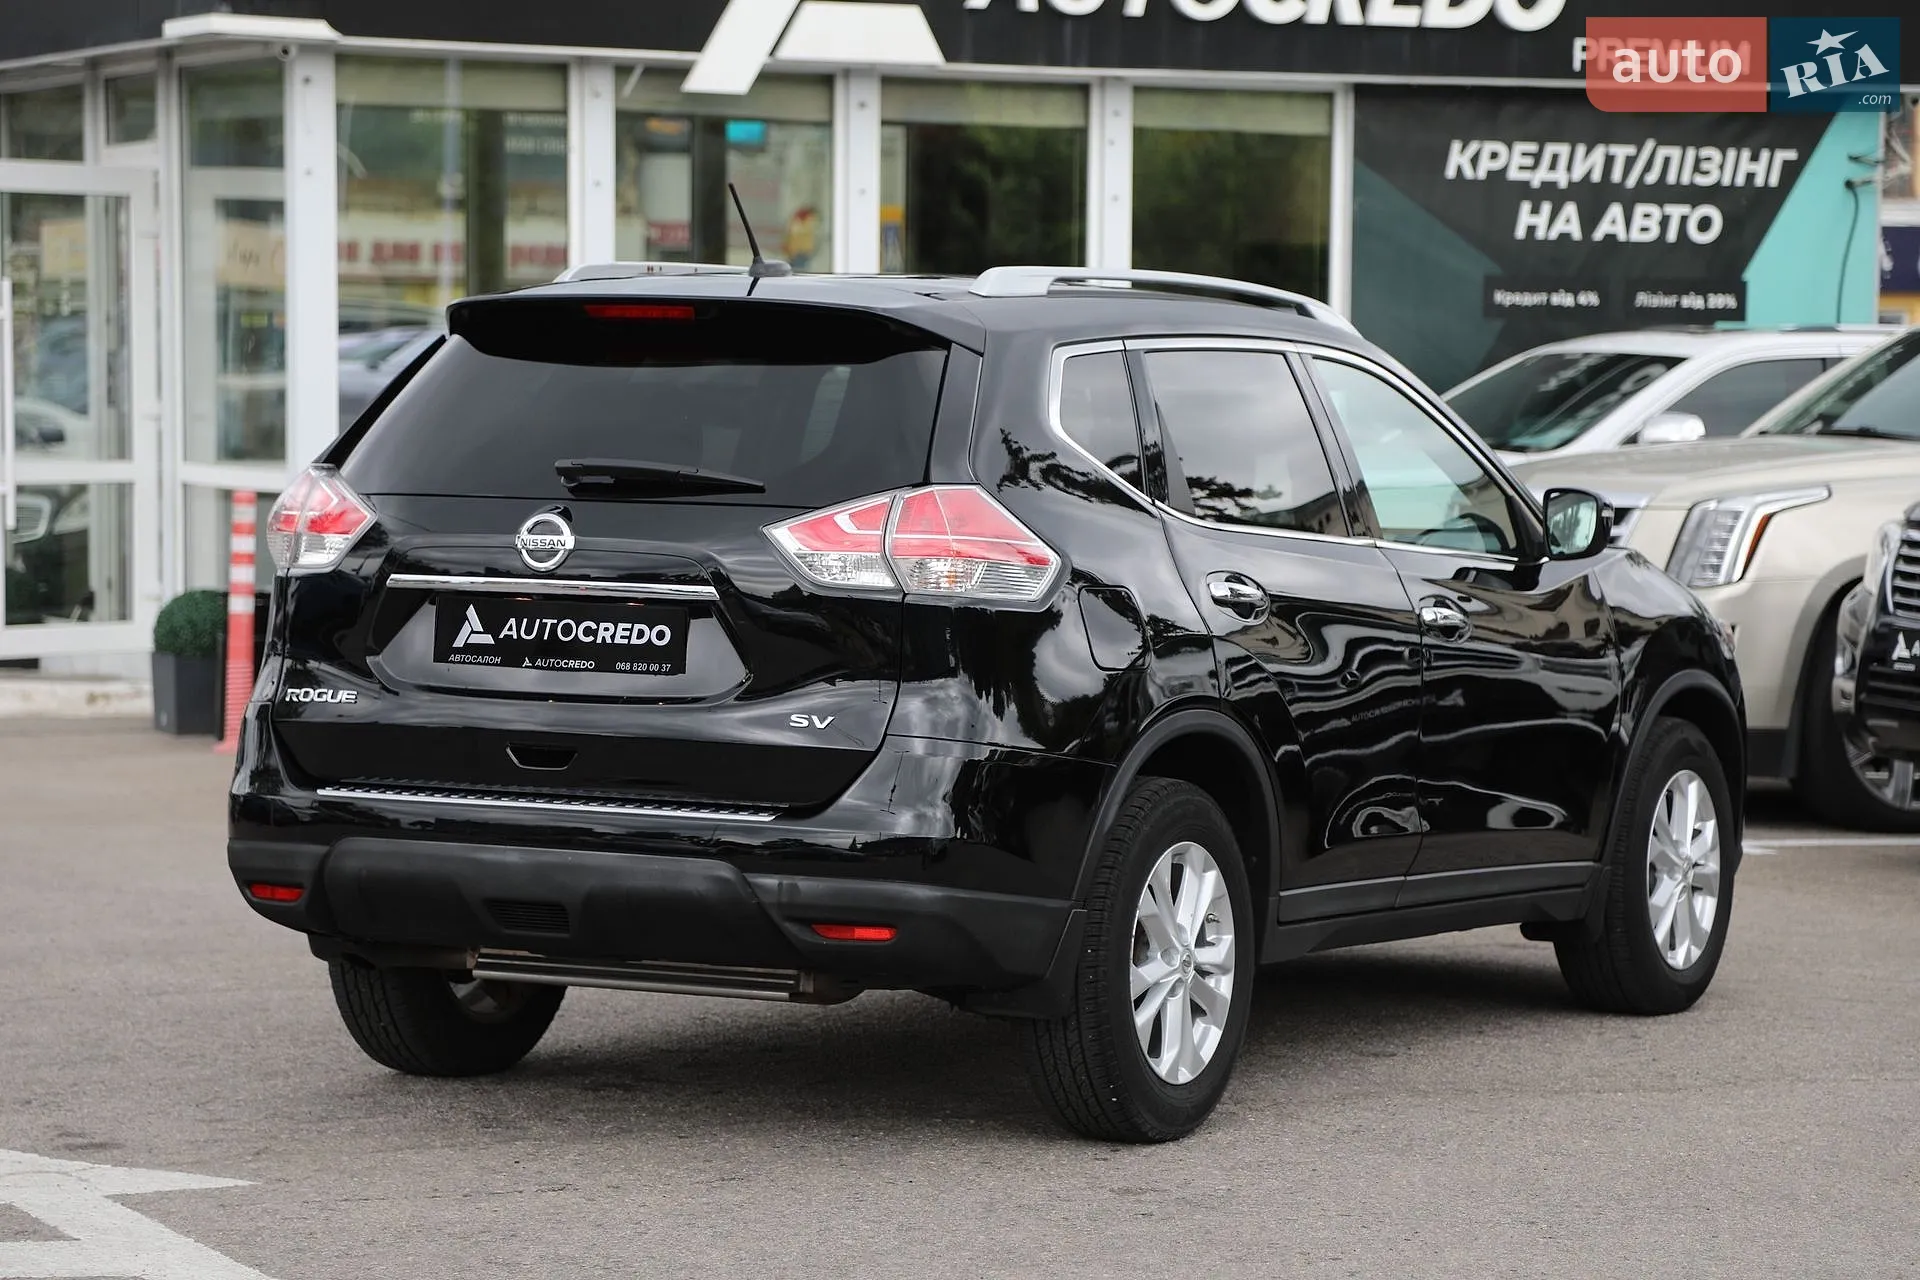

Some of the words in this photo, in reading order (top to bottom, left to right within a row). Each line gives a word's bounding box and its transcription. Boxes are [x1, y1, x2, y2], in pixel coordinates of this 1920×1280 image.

[1445, 138, 1799, 189] КРЕДИТ/ЛІЗІНГ
[1513, 199, 1583, 241] НА
[1591, 201, 1725, 245] АВТО
[520, 538, 566, 547] NISSAN
[498, 617, 671, 646] AUTOCREDO
[448, 653, 502, 664] АВТОСАЛОН
[534, 658, 595, 669] AUTOCREDO
[615, 661, 631, 671] 068
[632, 662, 648, 672] 820
[649, 663, 660, 672] 00
[661, 663, 672, 673] 37
[285, 687, 358, 704] ROGUE
[789, 713, 836, 730] SV
